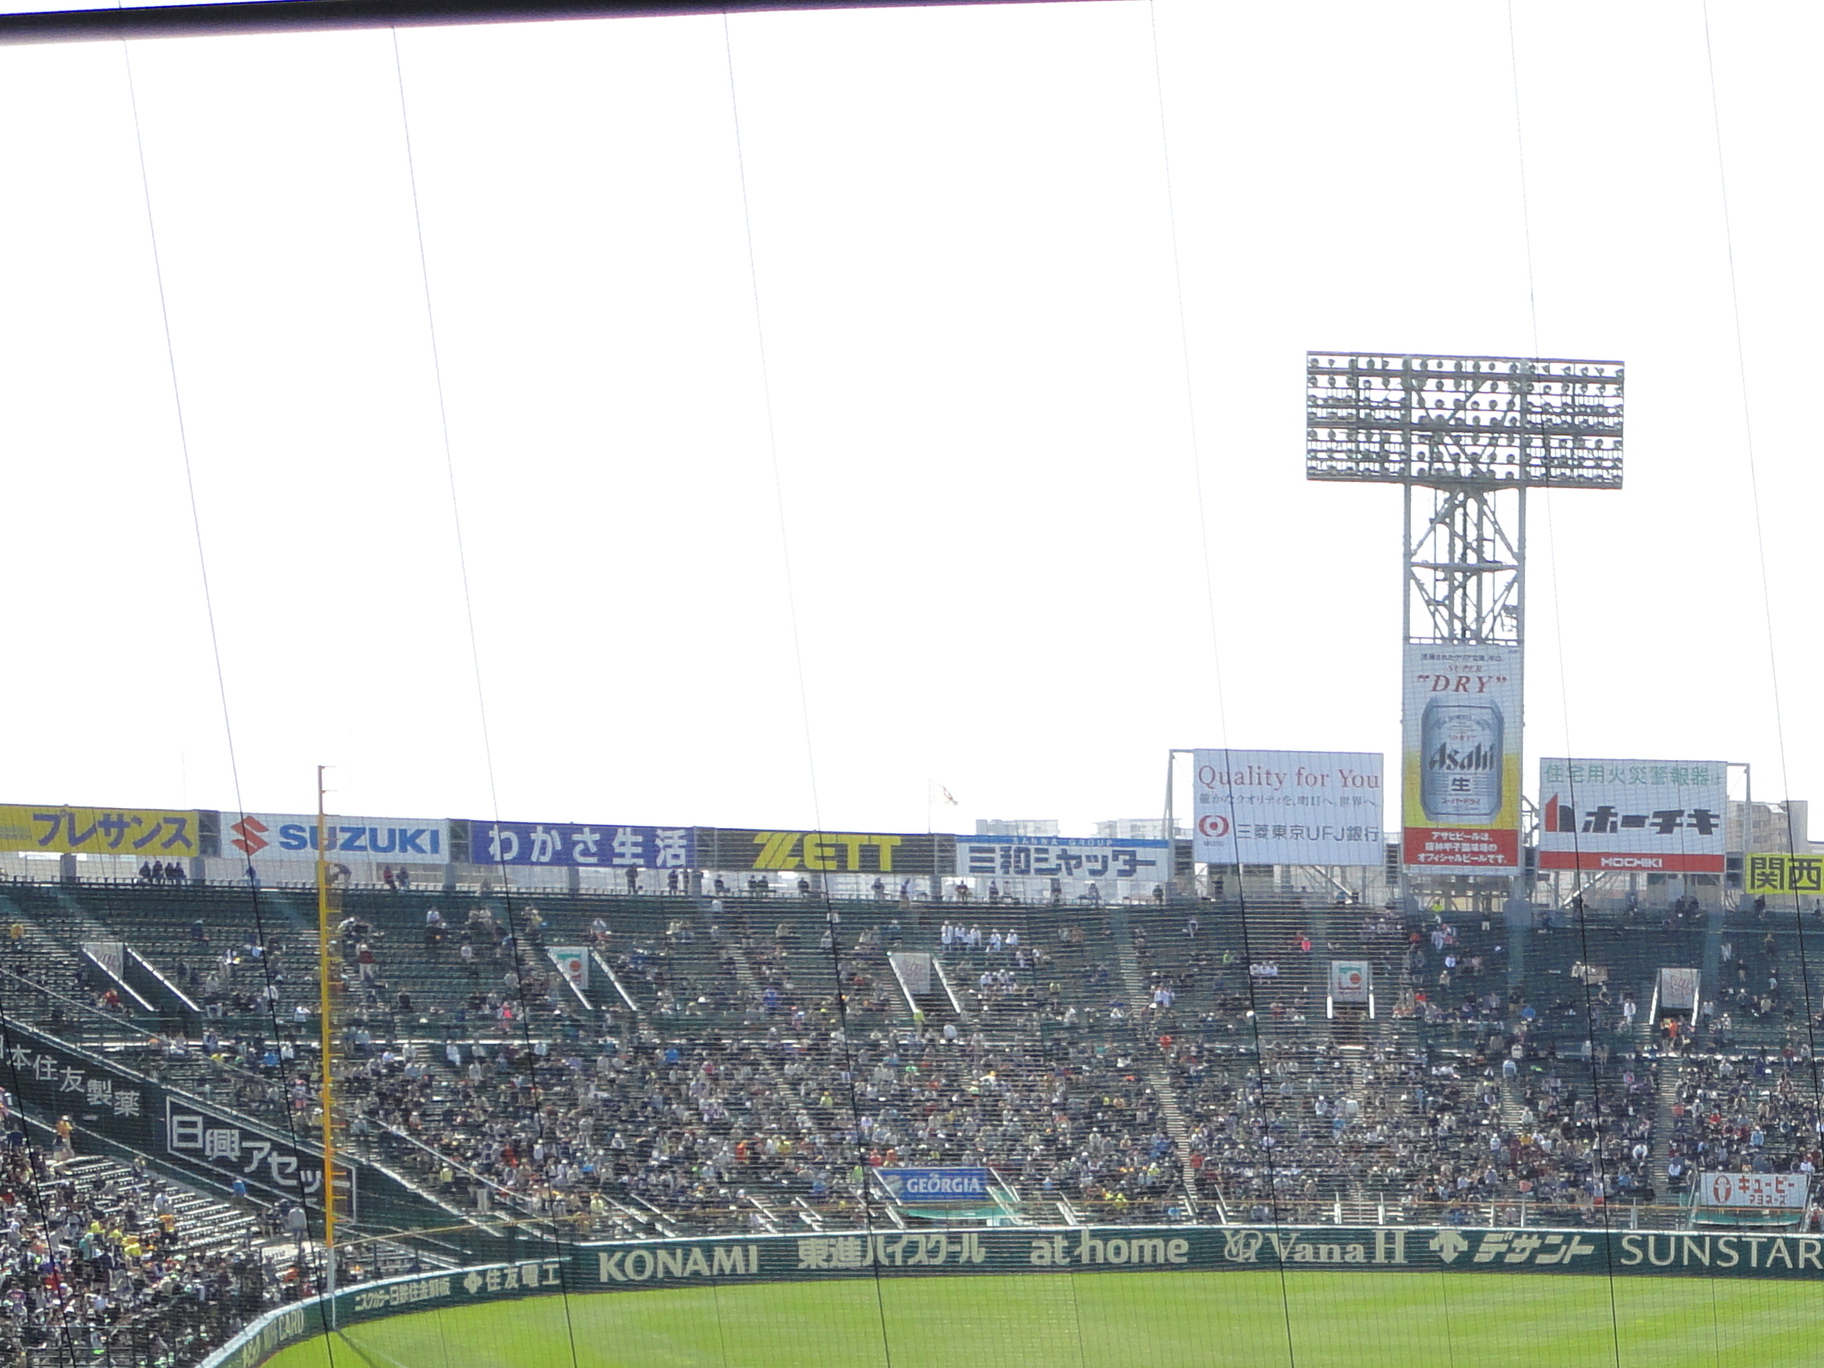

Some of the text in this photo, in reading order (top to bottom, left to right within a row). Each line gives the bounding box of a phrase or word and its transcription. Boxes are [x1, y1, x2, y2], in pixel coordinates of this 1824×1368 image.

[1448, 664, 1483, 673] SUPER
[1429, 741, 1495, 771] Asahi
[1198, 765, 1381, 791] Quality for You
[1451, 777, 1471, 792] 生
[32, 811, 193, 849] プレサンス
[1237, 823, 1380, 843] 三菱東京UFJ銀行
[1581, 805, 1721, 835] ホーチキ
[279, 823, 441, 855] SUZUKI
[488, 824, 688, 868] わかさ生活
[752, 832, 902, 873] ZETT
[1013, 837, 1113, 847] SANWA GROUP
[968, 845, 1157, 878] 三和シャッター
[1601, 857, 1664, 868] HOCHIKI
[0, 1035, 141, 1118] 本住友製薬
[906, 1175, 983, 1193] GEORGIA
[797, 1232, 987, 1270] 東進ハイスクール
[1077, 1227, 1190, 1265] home
[1473, 1235, 1595, 1264] デサント
[1621, 1235, 1824, 1270] SUNSTAR
[486, 1263, 560, 1292] 住友電工
[599, 1244, 760, 1284] KONAMI
